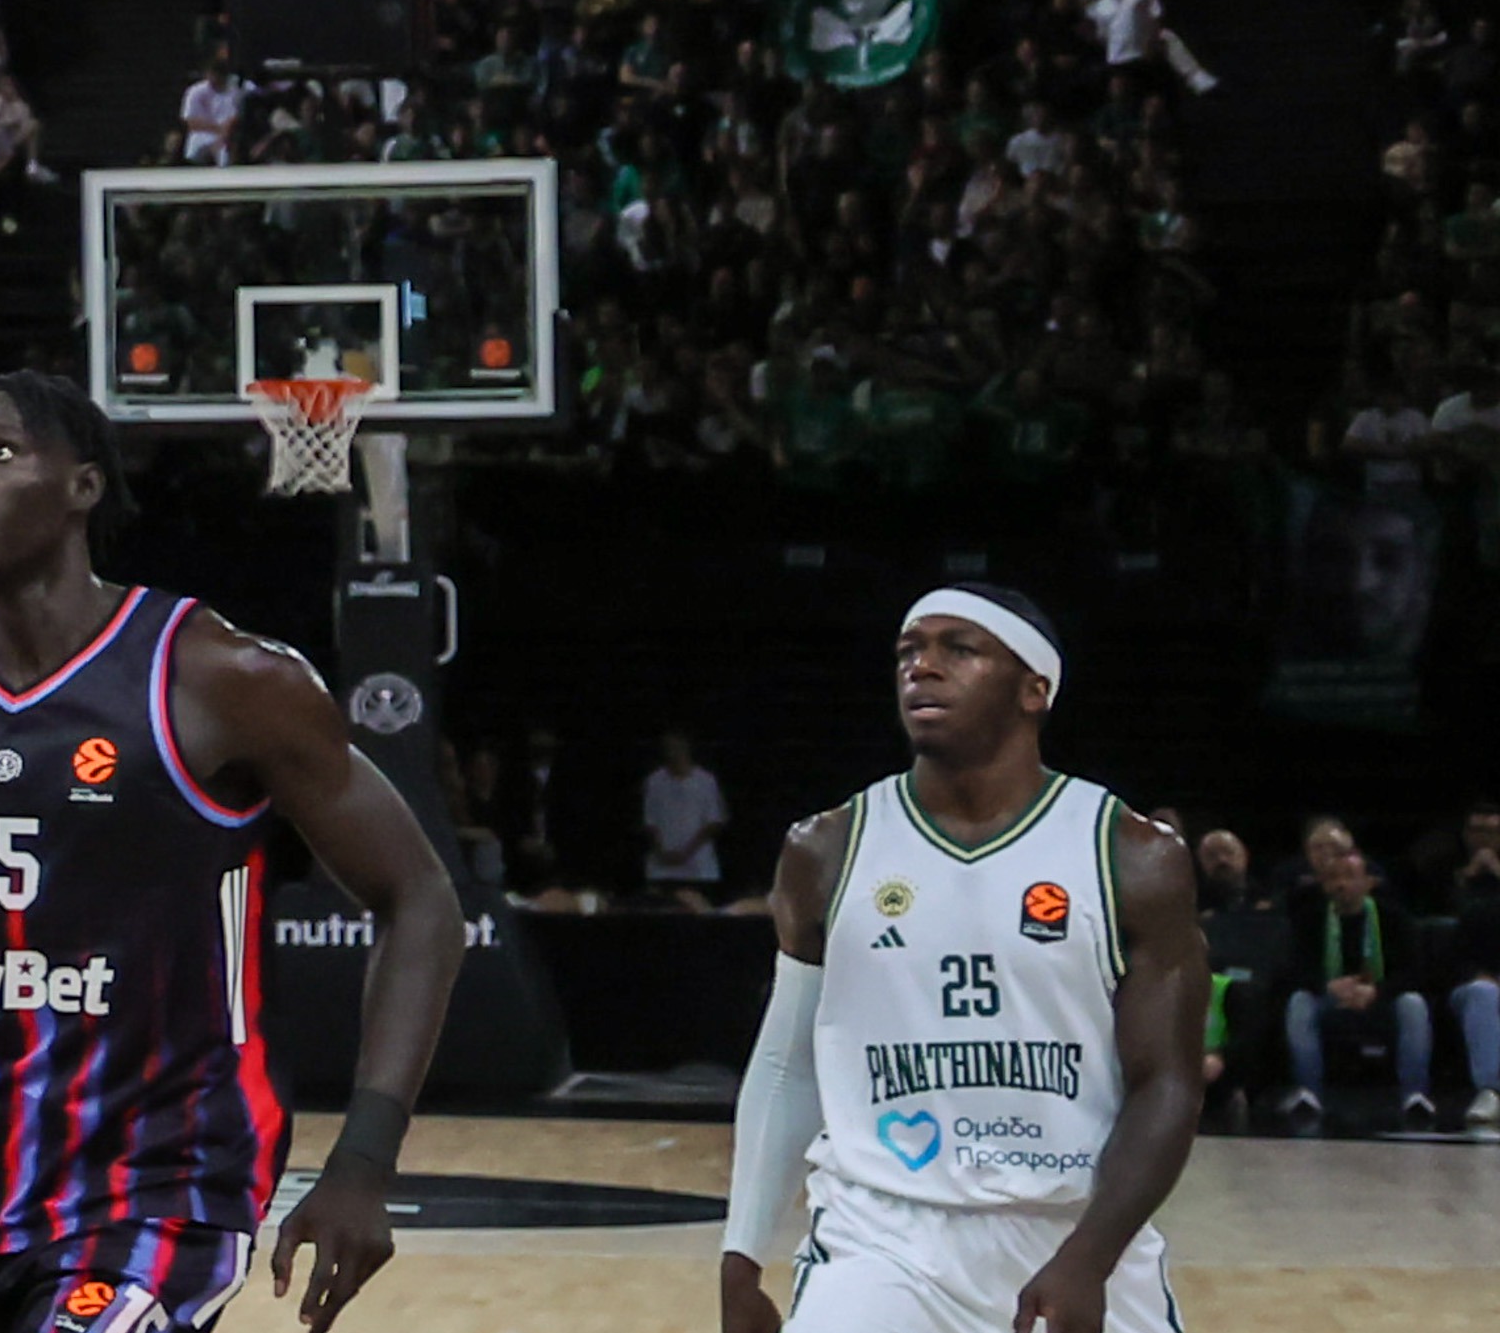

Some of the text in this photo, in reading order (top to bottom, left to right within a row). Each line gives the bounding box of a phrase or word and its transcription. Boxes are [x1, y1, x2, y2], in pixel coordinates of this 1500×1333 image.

[940, 954, 1001, 1018] 25
[865, 1041, 1083, 1105] PANATHINAIKOS
[954, 1117, 1043, 1141] Ομάδα
